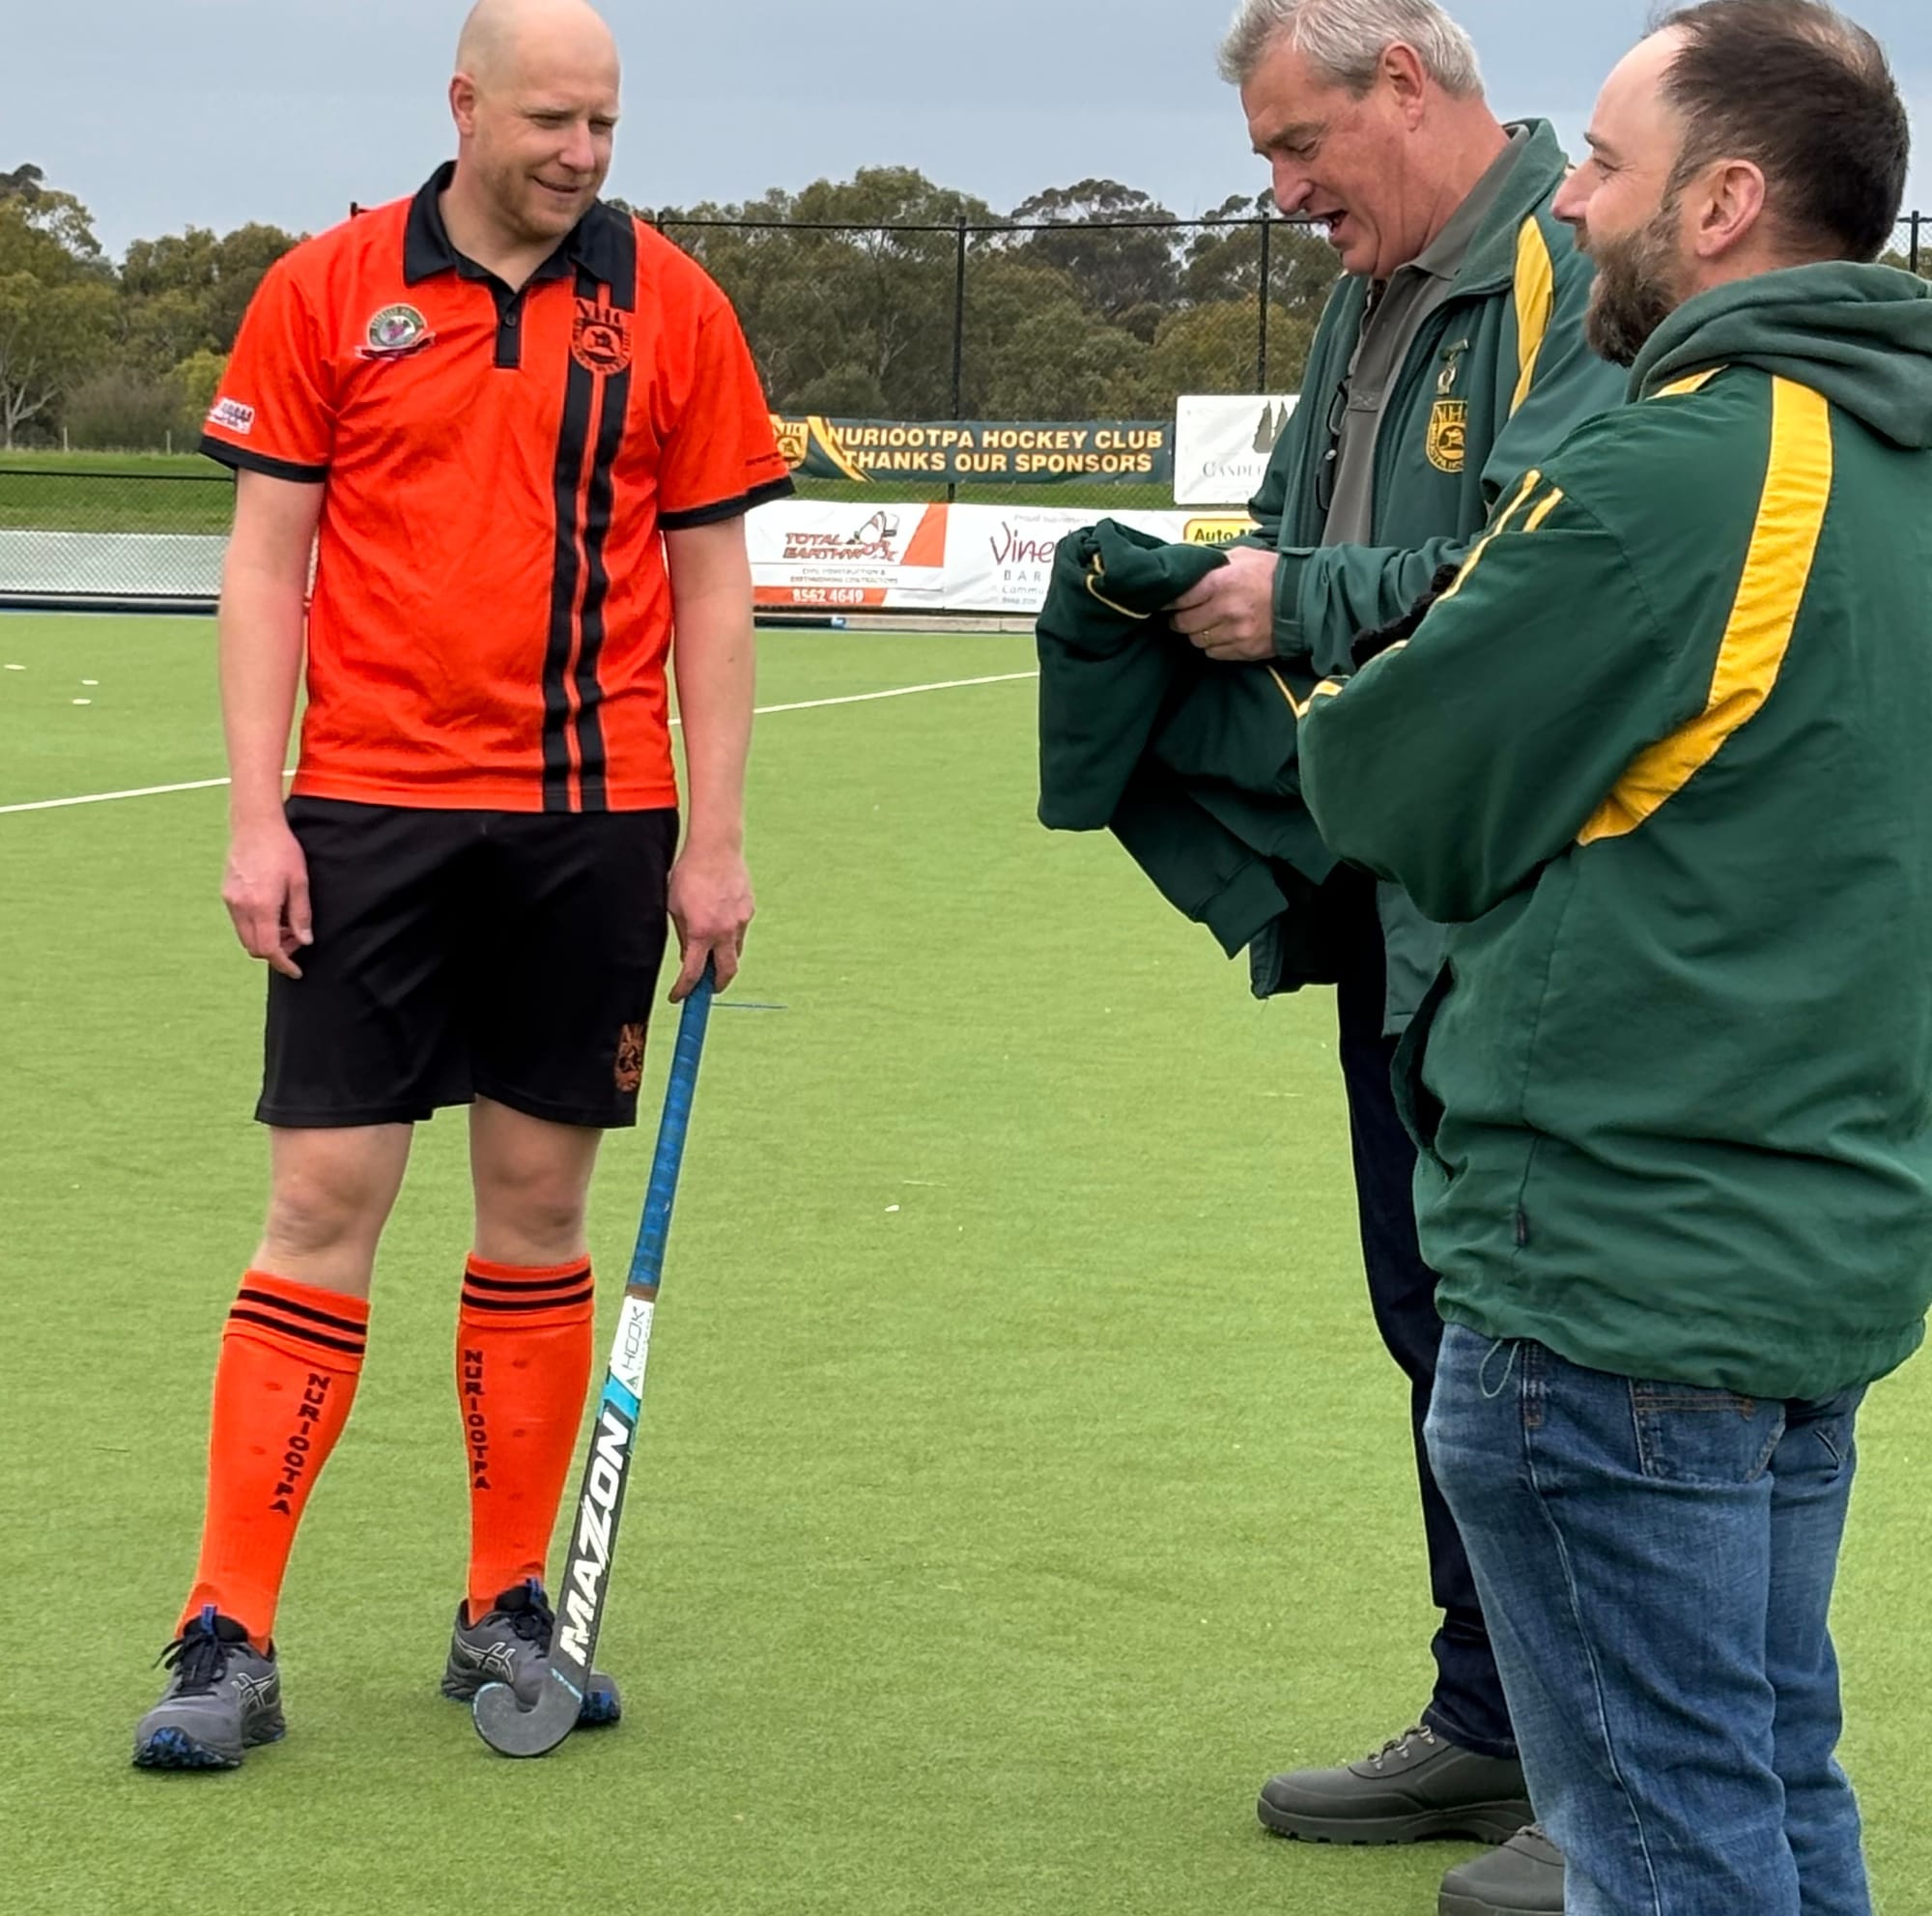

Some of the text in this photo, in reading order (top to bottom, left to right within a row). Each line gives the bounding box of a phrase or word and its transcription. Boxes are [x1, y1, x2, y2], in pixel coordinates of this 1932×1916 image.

[828, 425, 1163, 449] NURIOOTPA HOCKEY CLUB
[842, 449, 1152, 473] THANKS OUR SPONSORS
[785, 532, 841, 545] TOTAL
[989, 521, 1055, 566] Vine
[1194, 528, 1234, 545] Auto
[792, 588, 864, 603] 8562 4649
[465, 1349, 491, 1490] NURIOOTPA
[269, 1372, 331, 1515] NURIOOTPA
[559, 1410, 629, 1667] MAZON
